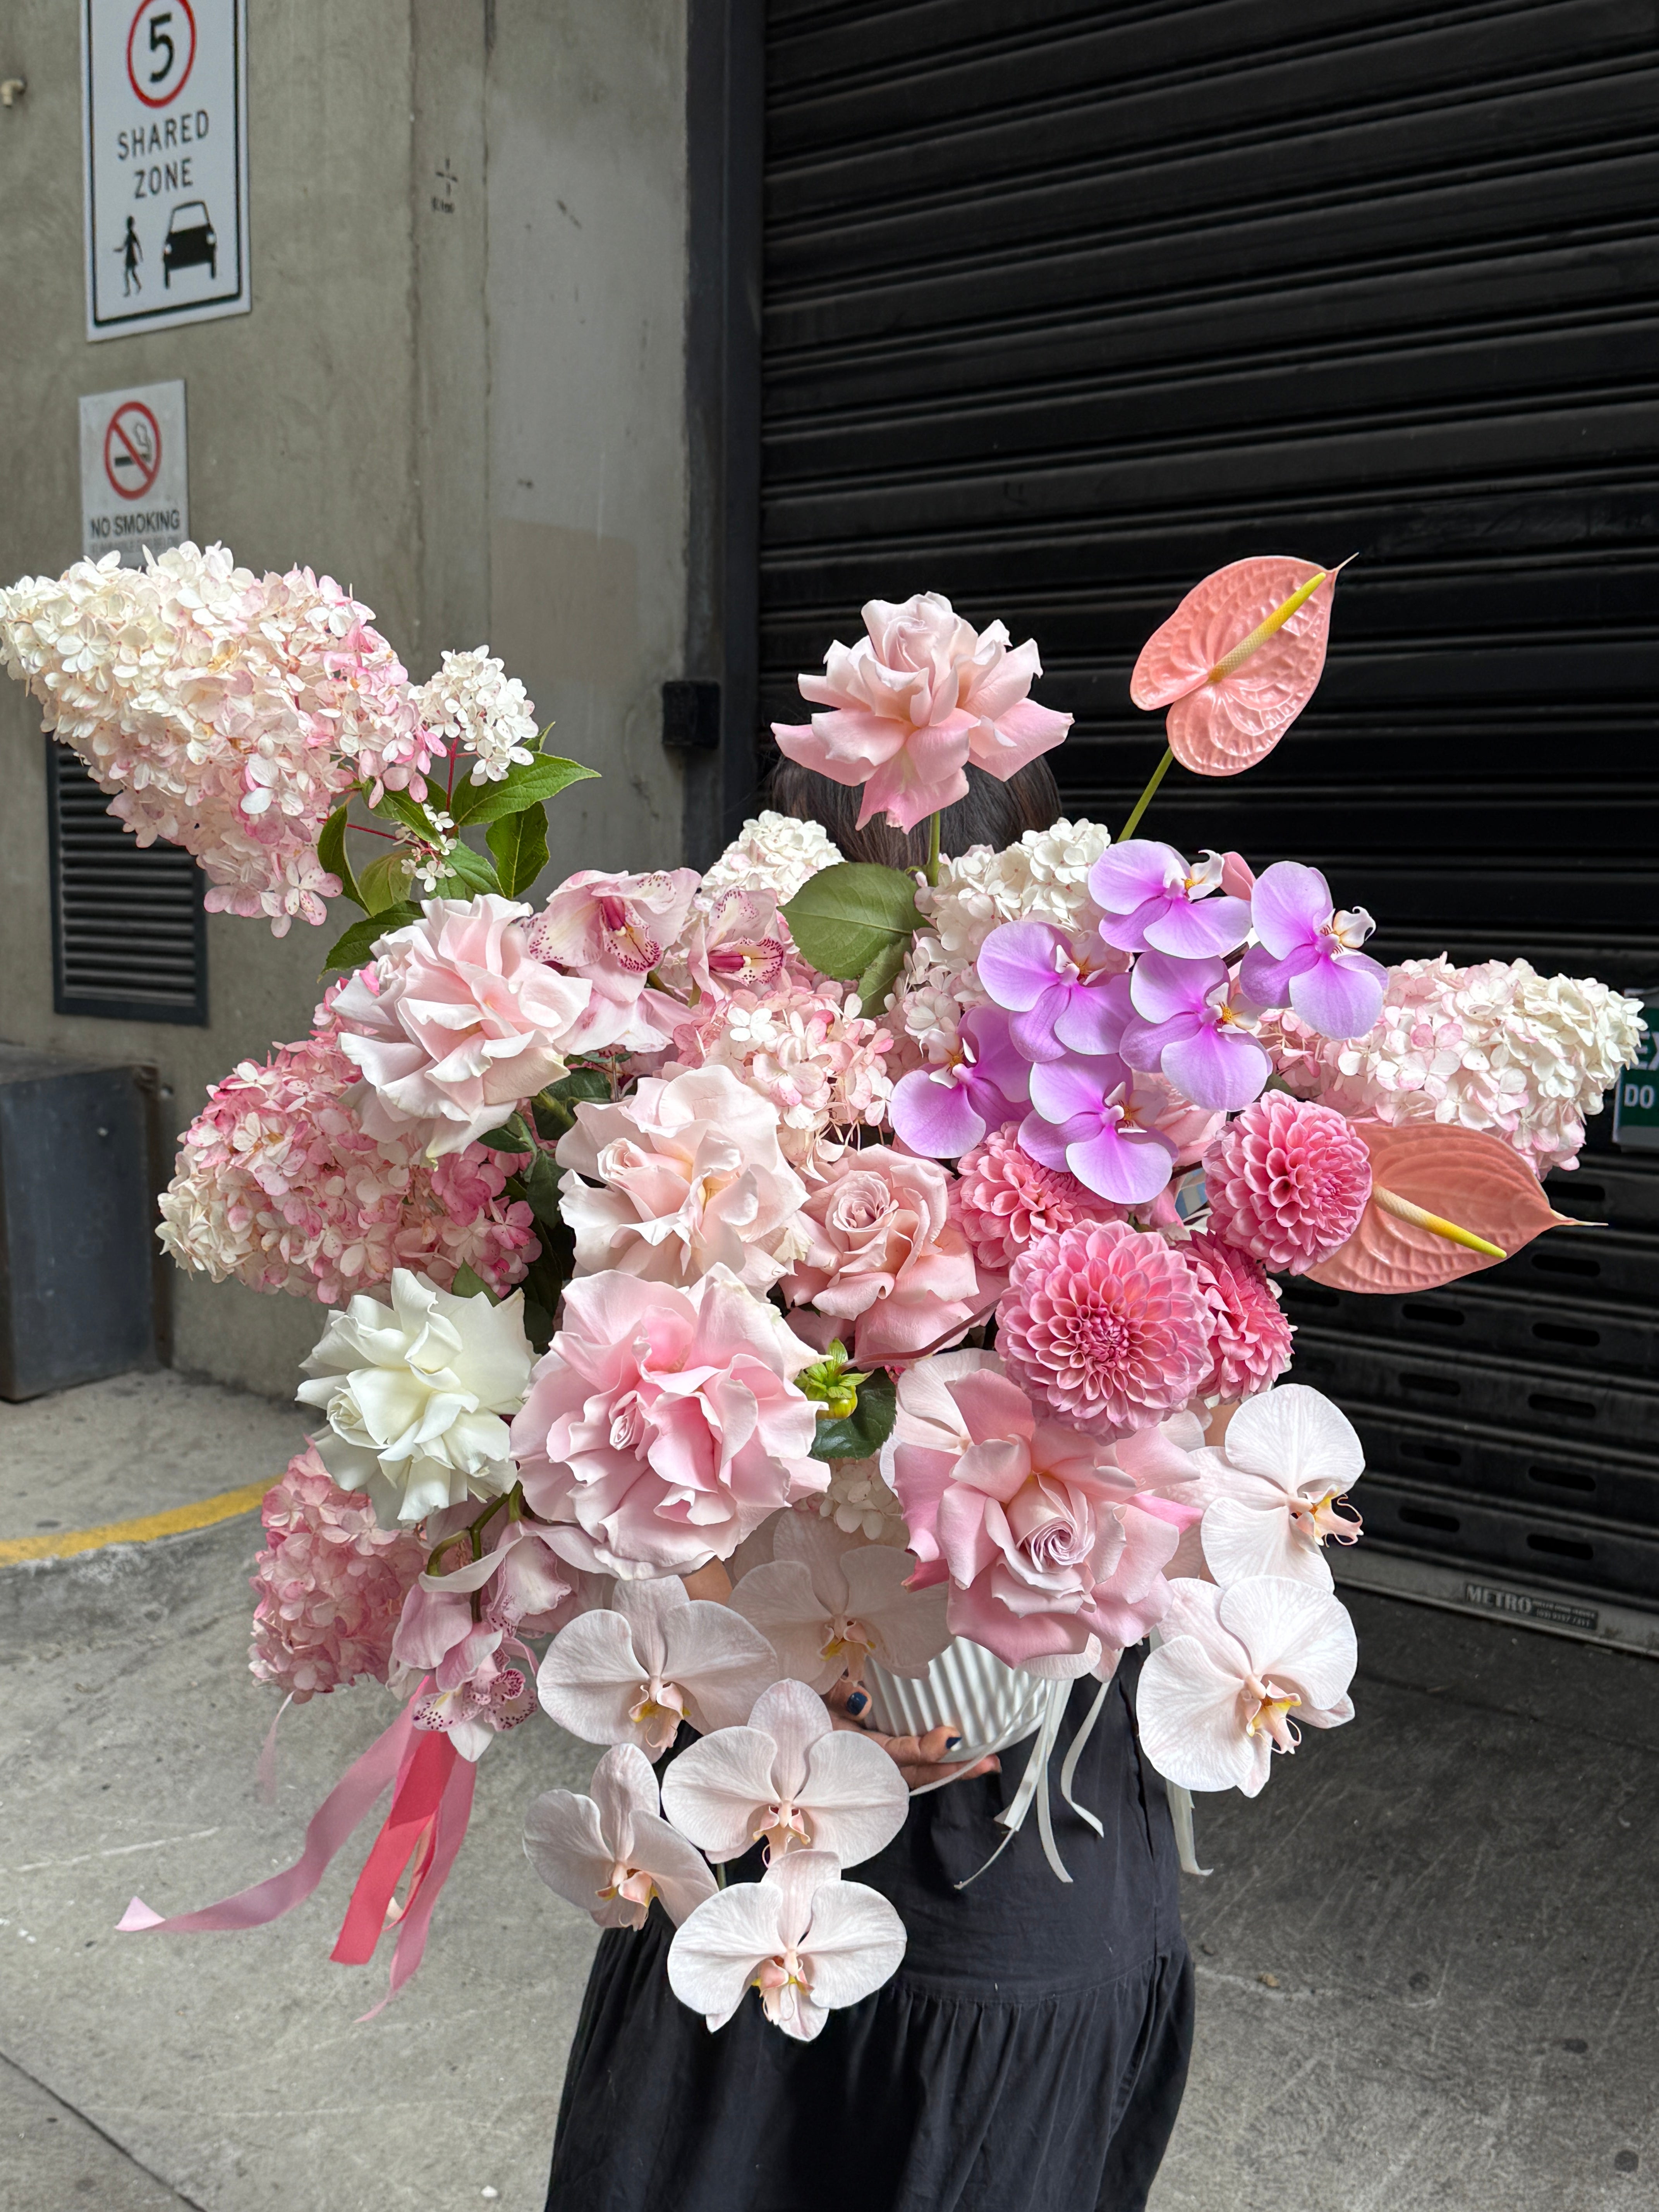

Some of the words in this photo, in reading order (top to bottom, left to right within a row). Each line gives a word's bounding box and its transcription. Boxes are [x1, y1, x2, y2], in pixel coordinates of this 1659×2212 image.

[149, 13, 174, 83] 5
[117, 109, 209, 160] SHARED
[134, 158, 193, 199] ZONE
[91, 516, 110, 538] NO
[114, 509, 180, 536] SMOKING
[1624, 1084, 1655, 1109] DO
[1466, 1584, 1531, 1613] METRO
